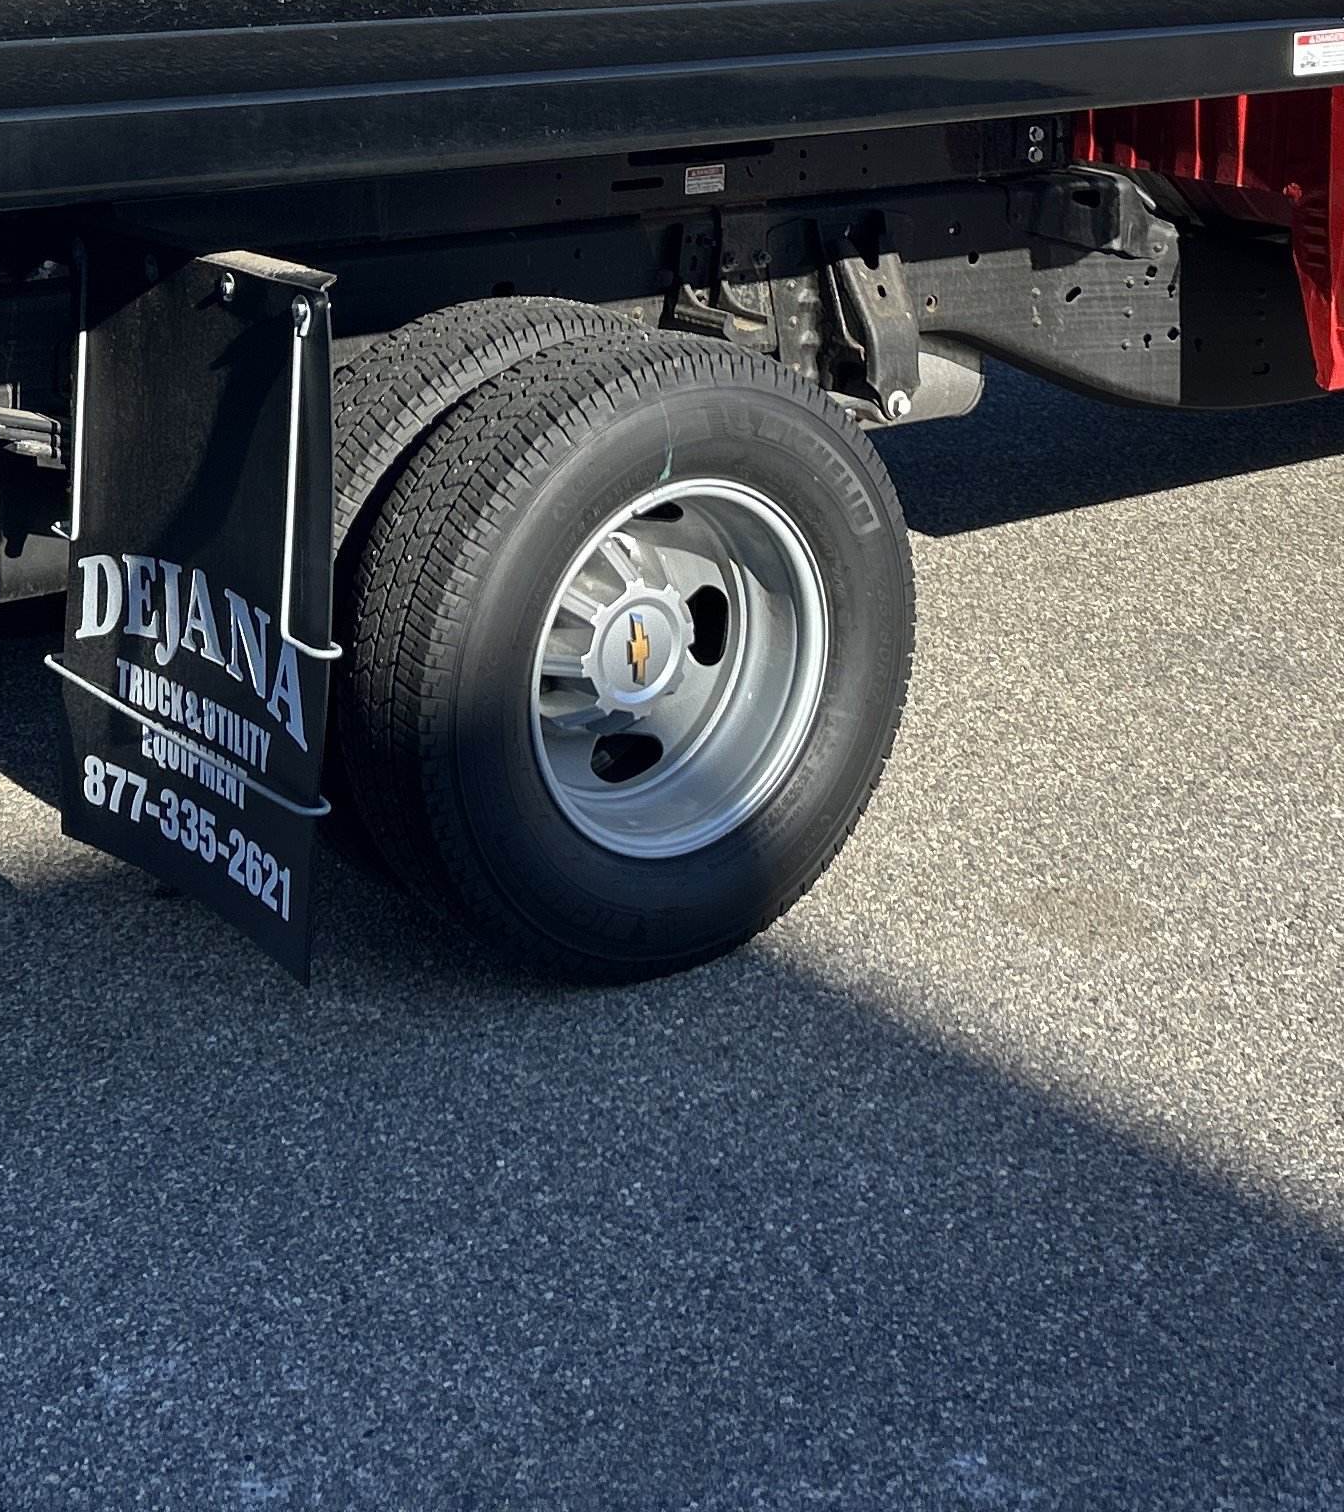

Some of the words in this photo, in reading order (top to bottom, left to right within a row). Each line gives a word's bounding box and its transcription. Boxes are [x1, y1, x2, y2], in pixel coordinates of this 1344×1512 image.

[75, 553, 308, 752] DEJANA
[83, 754, 291, 922] 877-335-2621
[141, 722, 248, 811] EQUIPMENT
